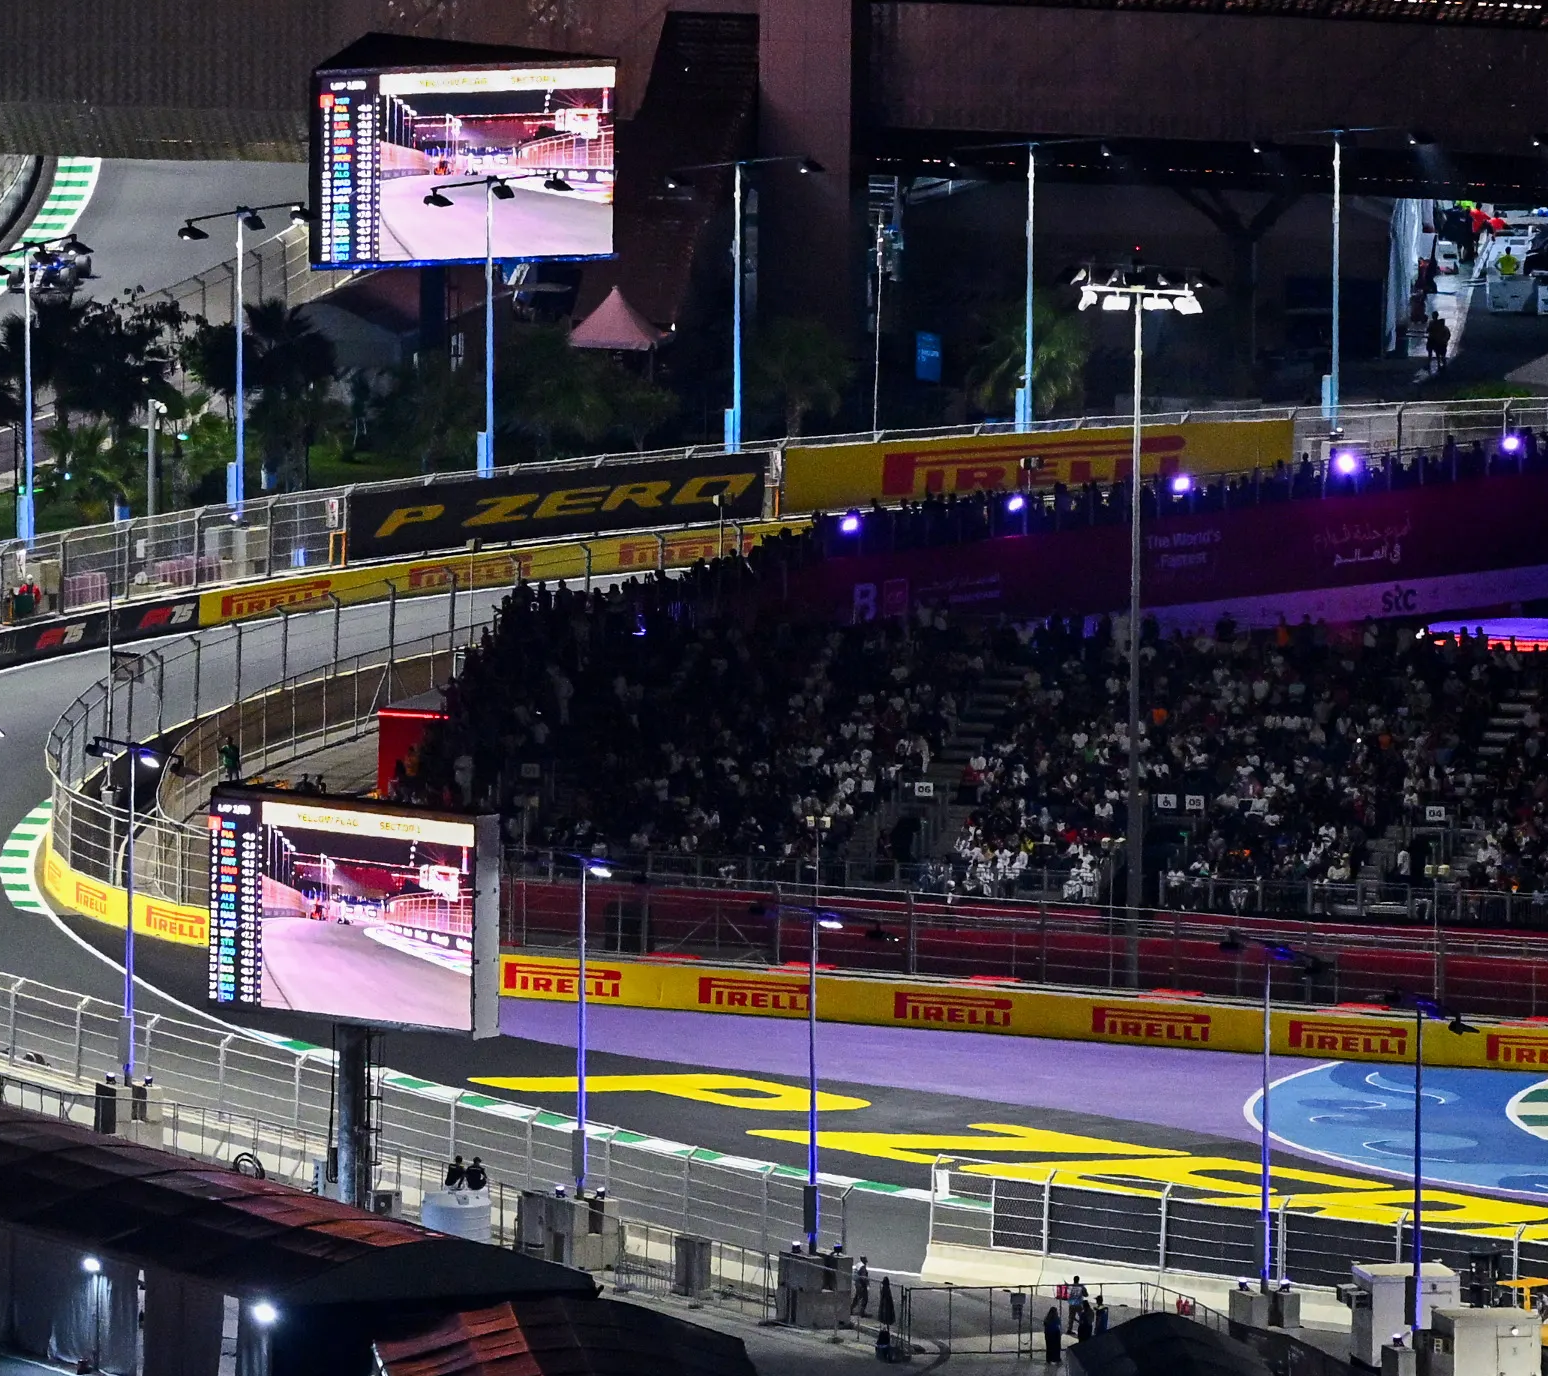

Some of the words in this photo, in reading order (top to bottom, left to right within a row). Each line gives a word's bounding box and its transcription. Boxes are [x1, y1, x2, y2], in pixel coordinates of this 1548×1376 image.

[373, 505, 444, 539] P
[462, 472, 757, 528] ZERO
[169, 603, 195, 624] 75
[222, 580, 332, 616] PIRELLI
[1382, 585, 1417, 612] stc
[379, 821, 416, 832] SECTOR
[76, 882, 107, 915] PIRELLI
[146, 905, 204, 939] PIRELLI
[505, 962, 622, 997] PIRELLI
[698, 976, 810, 1010] PIRELLI
[894, 992, 1012, 1026] PIRELLI
[1092, 1006, 1211, 1042] PIRELLI
[1289, 1020, 1408, 1055] PIRELLI
